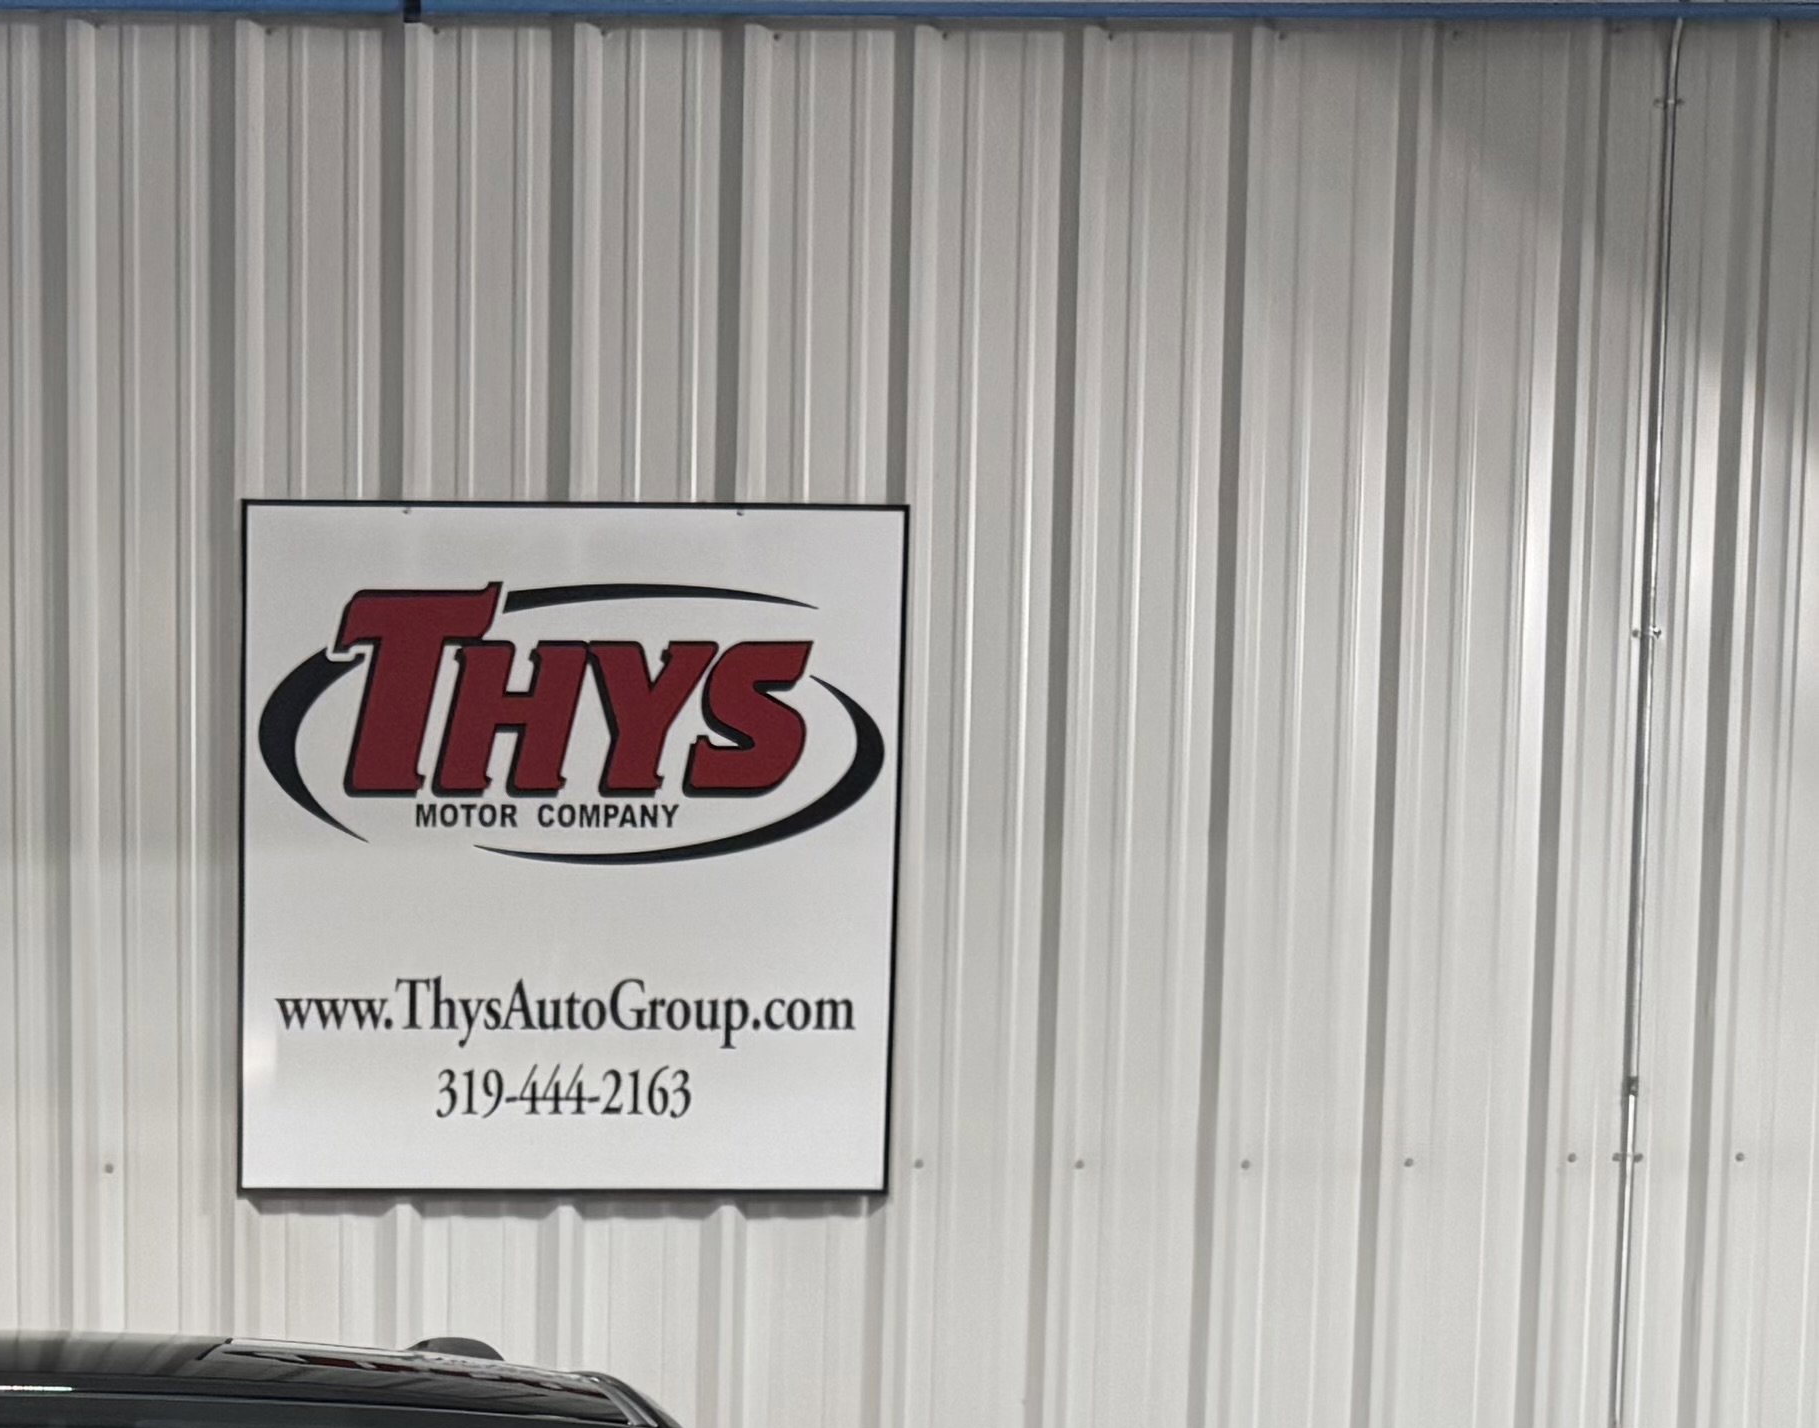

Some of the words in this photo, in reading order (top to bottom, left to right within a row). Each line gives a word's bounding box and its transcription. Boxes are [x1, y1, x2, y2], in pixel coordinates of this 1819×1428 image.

[333, 580, 814, 799] THYS
[414, 803, 519, 829] MOTOR
[536, 803, 681, 829] COMPANY
[275, 975, 856, 1050] www.ThysAutoGroup.com
[435, 1064, 692, 1119] 319-444-2163
